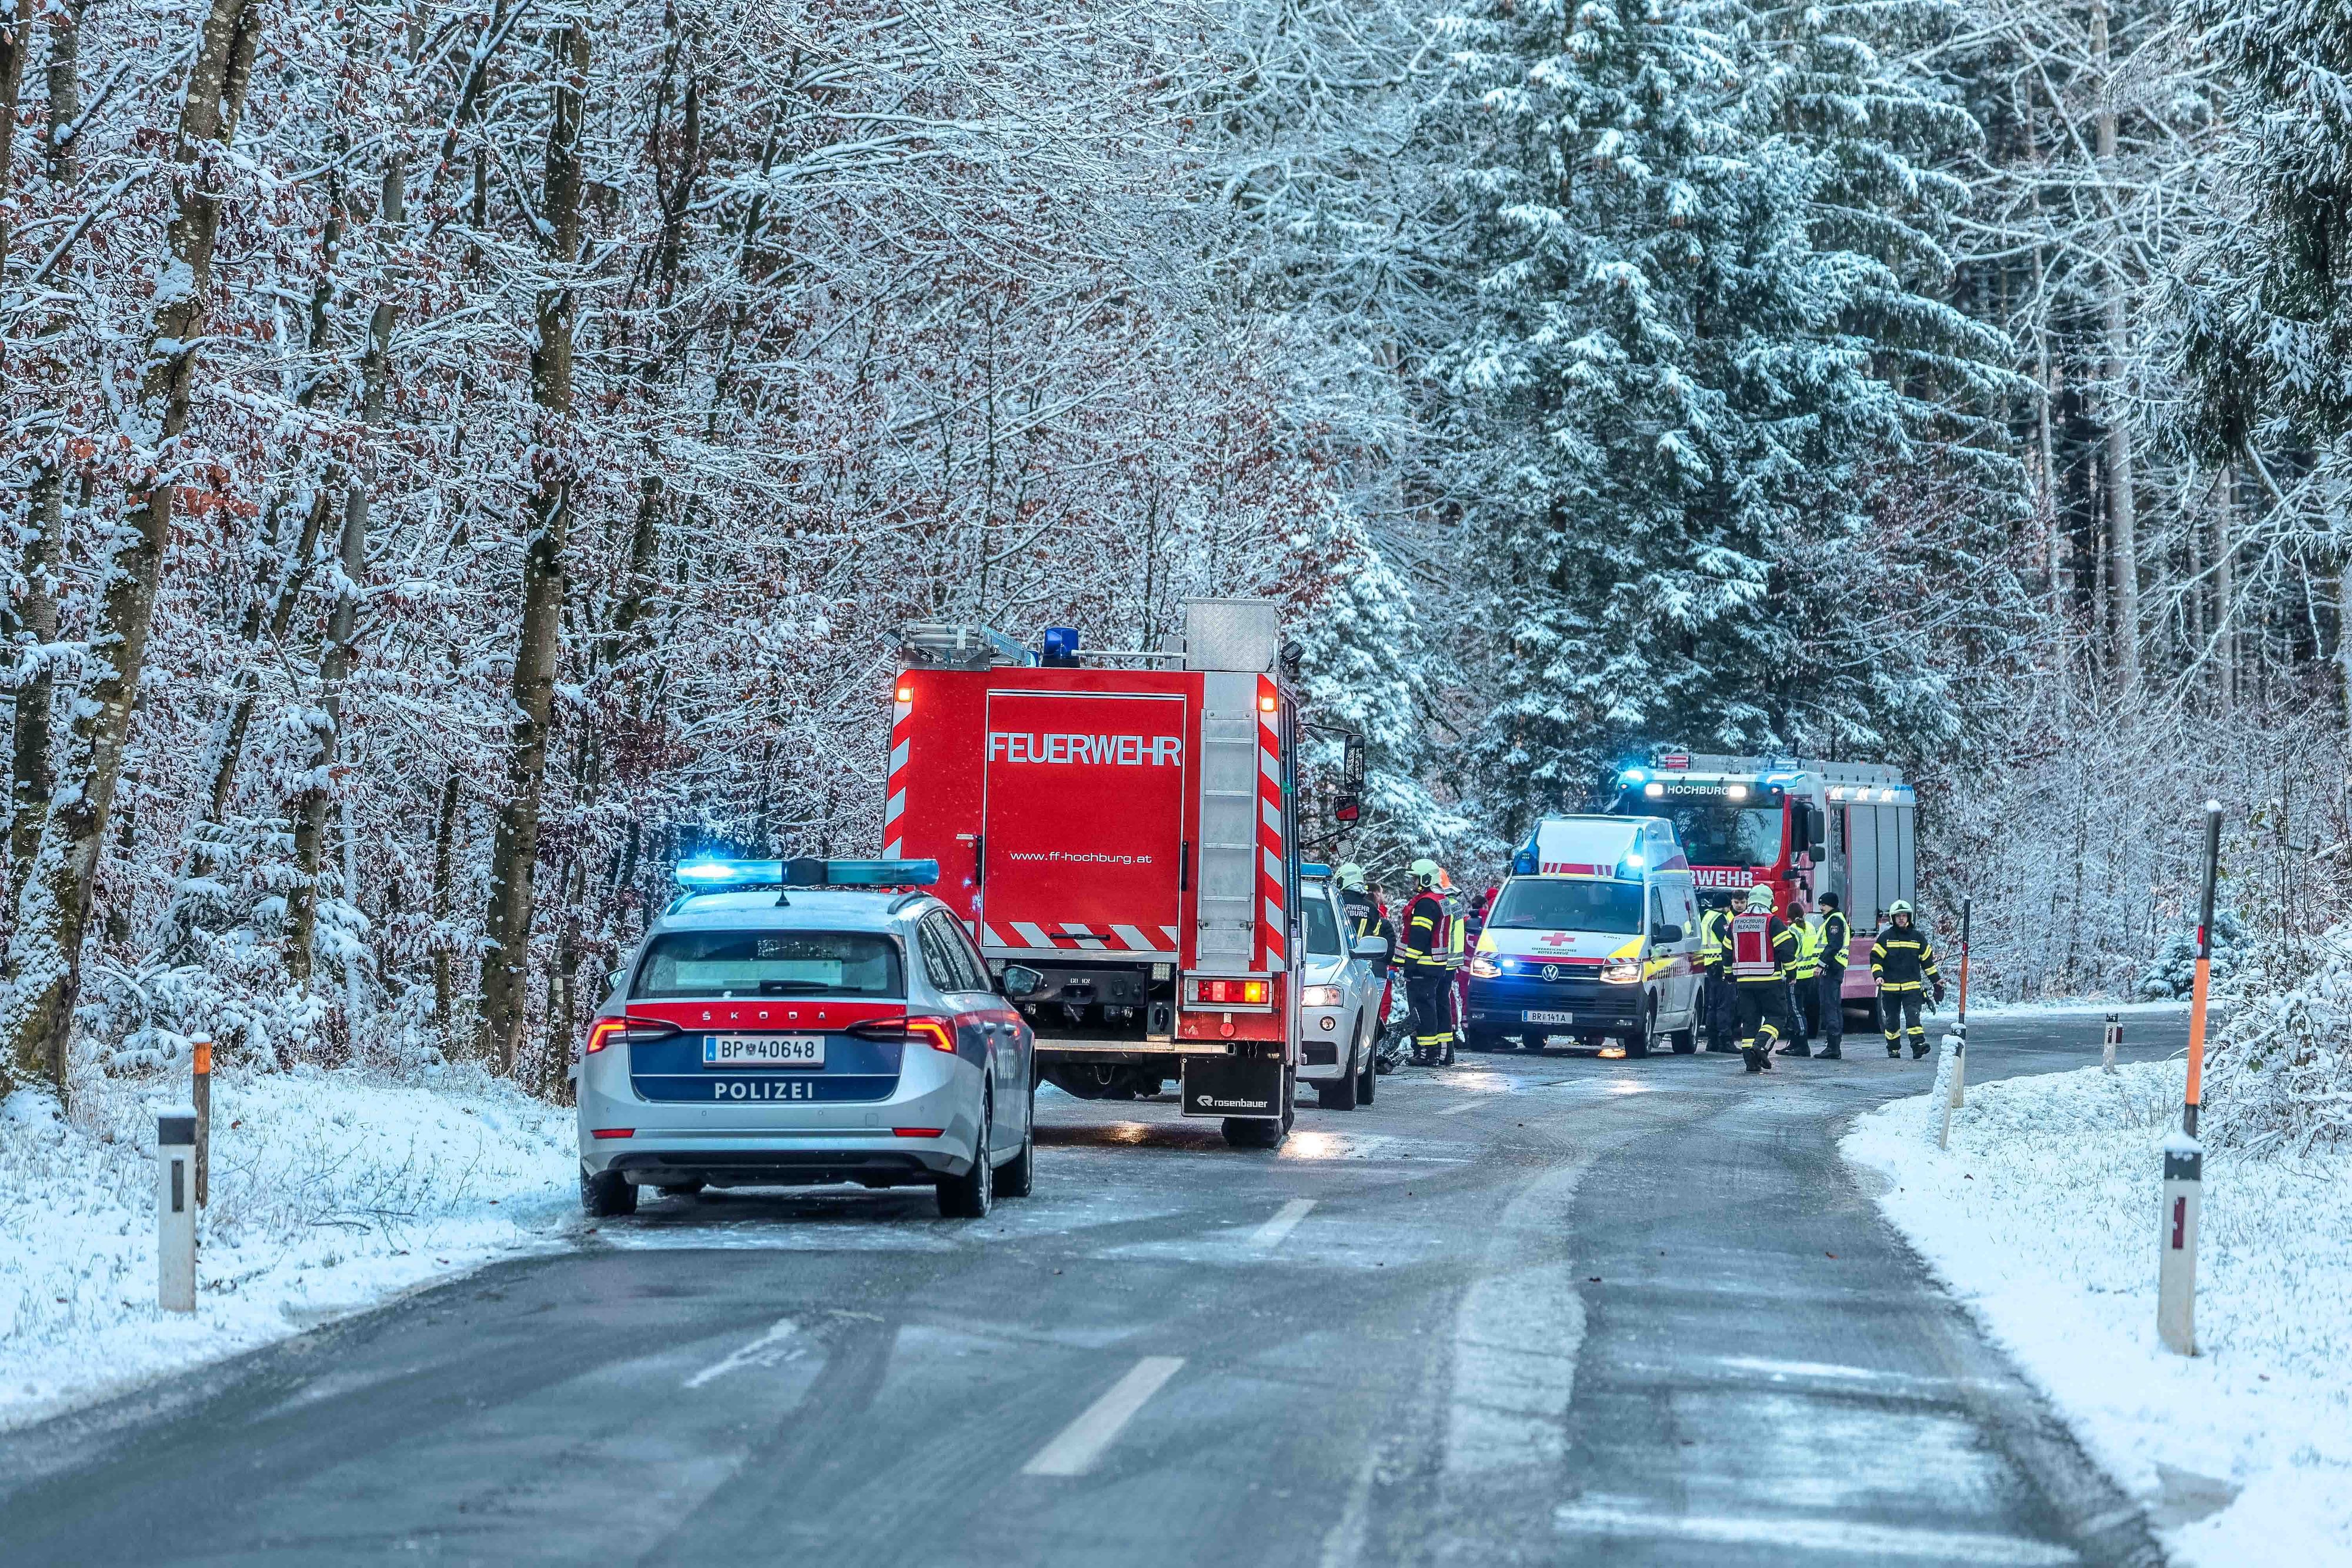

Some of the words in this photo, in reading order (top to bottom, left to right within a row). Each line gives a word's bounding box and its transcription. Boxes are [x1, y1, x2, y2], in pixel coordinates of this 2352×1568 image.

[988, 732, 1182, 766] FEUERWEHR
[1668, 785, 1729, 795] HOCHBURG
[1010, 852, 1152, 864] www.ff-hochburg.at
[1532, 1012, 1542, 1021] BR
[721, 1041, 743, 1058] BP
[758, 1041, 814, 1058] 40648
[714, 1082, 813, 1099] POLIZEI
[1214, 1098, 1268, 1108] rosenbauer
